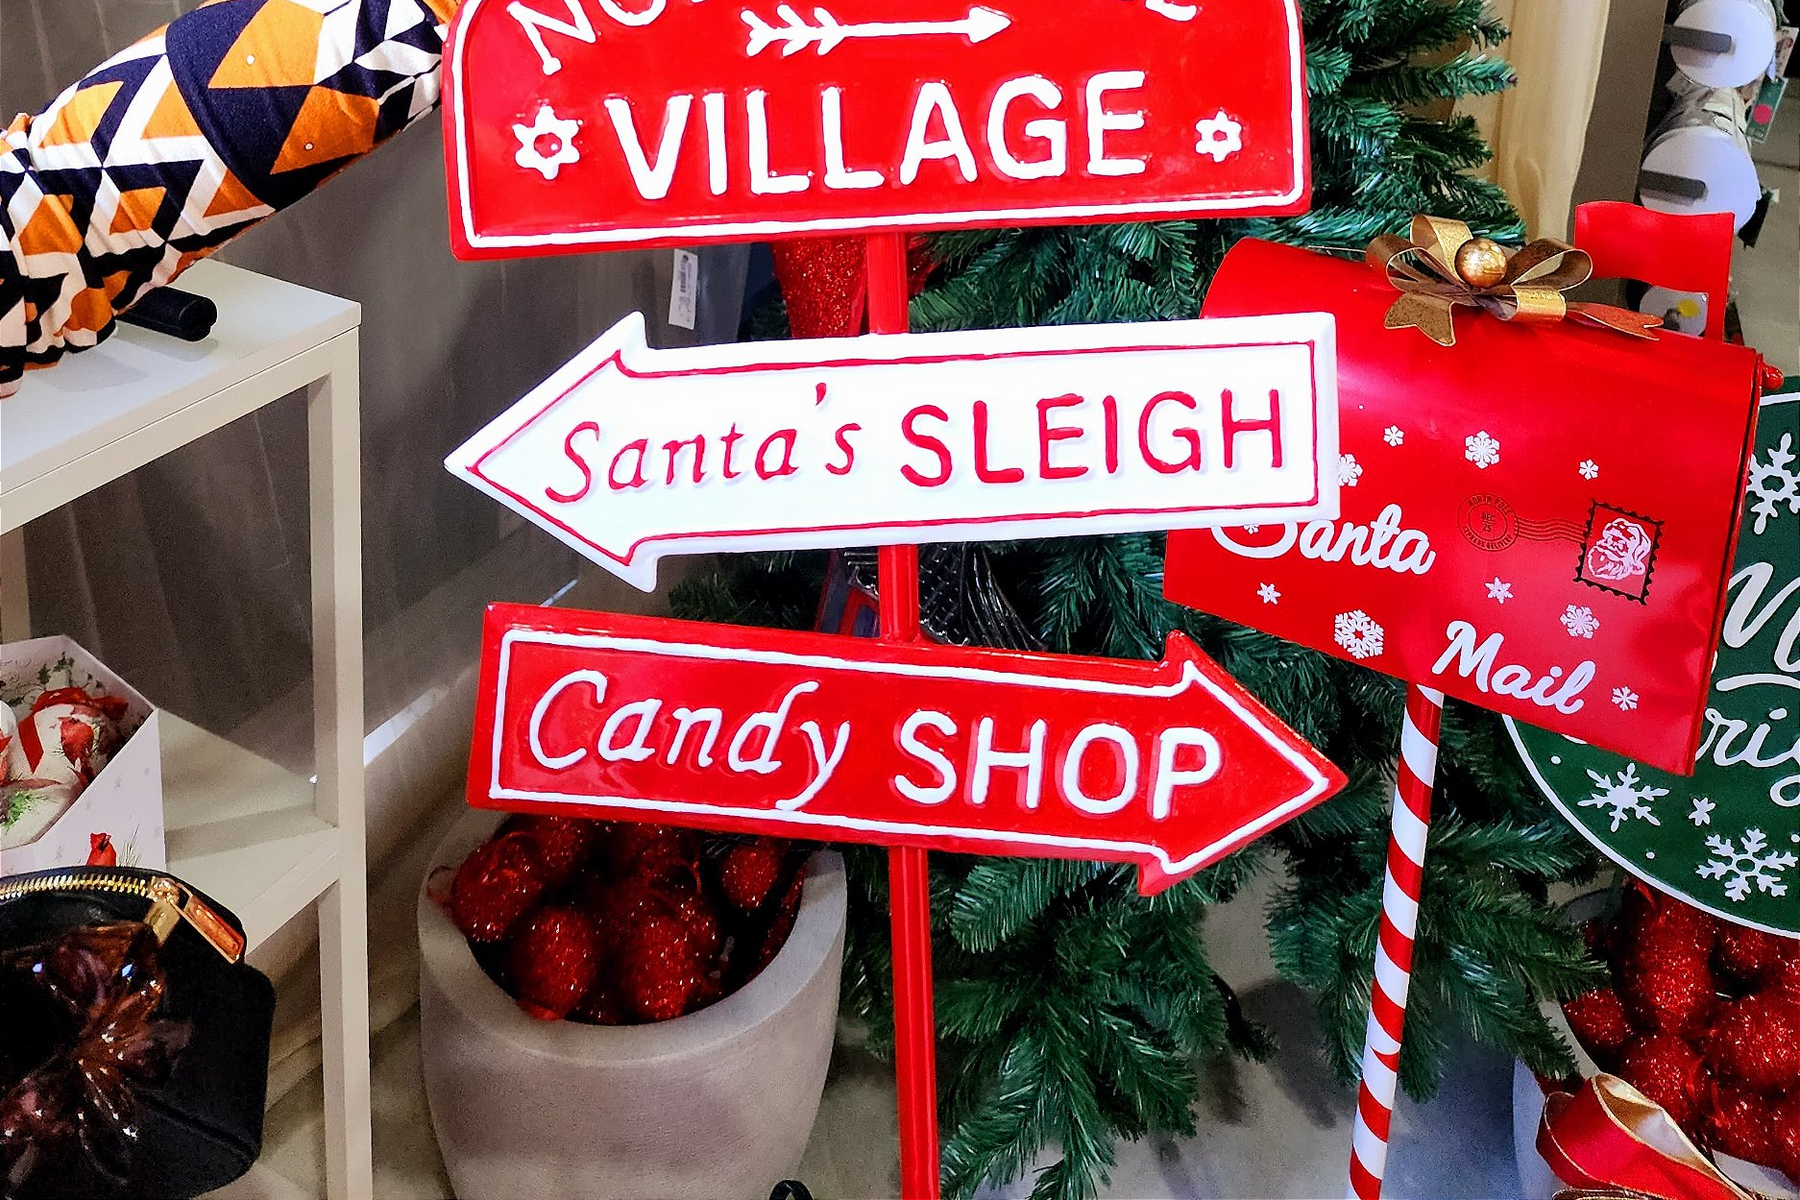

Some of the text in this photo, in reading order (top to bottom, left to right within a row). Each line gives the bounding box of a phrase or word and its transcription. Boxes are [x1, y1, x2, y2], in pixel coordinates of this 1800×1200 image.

[603, 71, 1147, 199] VILLAGE
[546, 382, 1284, 504] Santa's SLEIGH
[1432, 620, 1597, 714] Mail
[527, 668, 1223, 820] Candy SHOP
